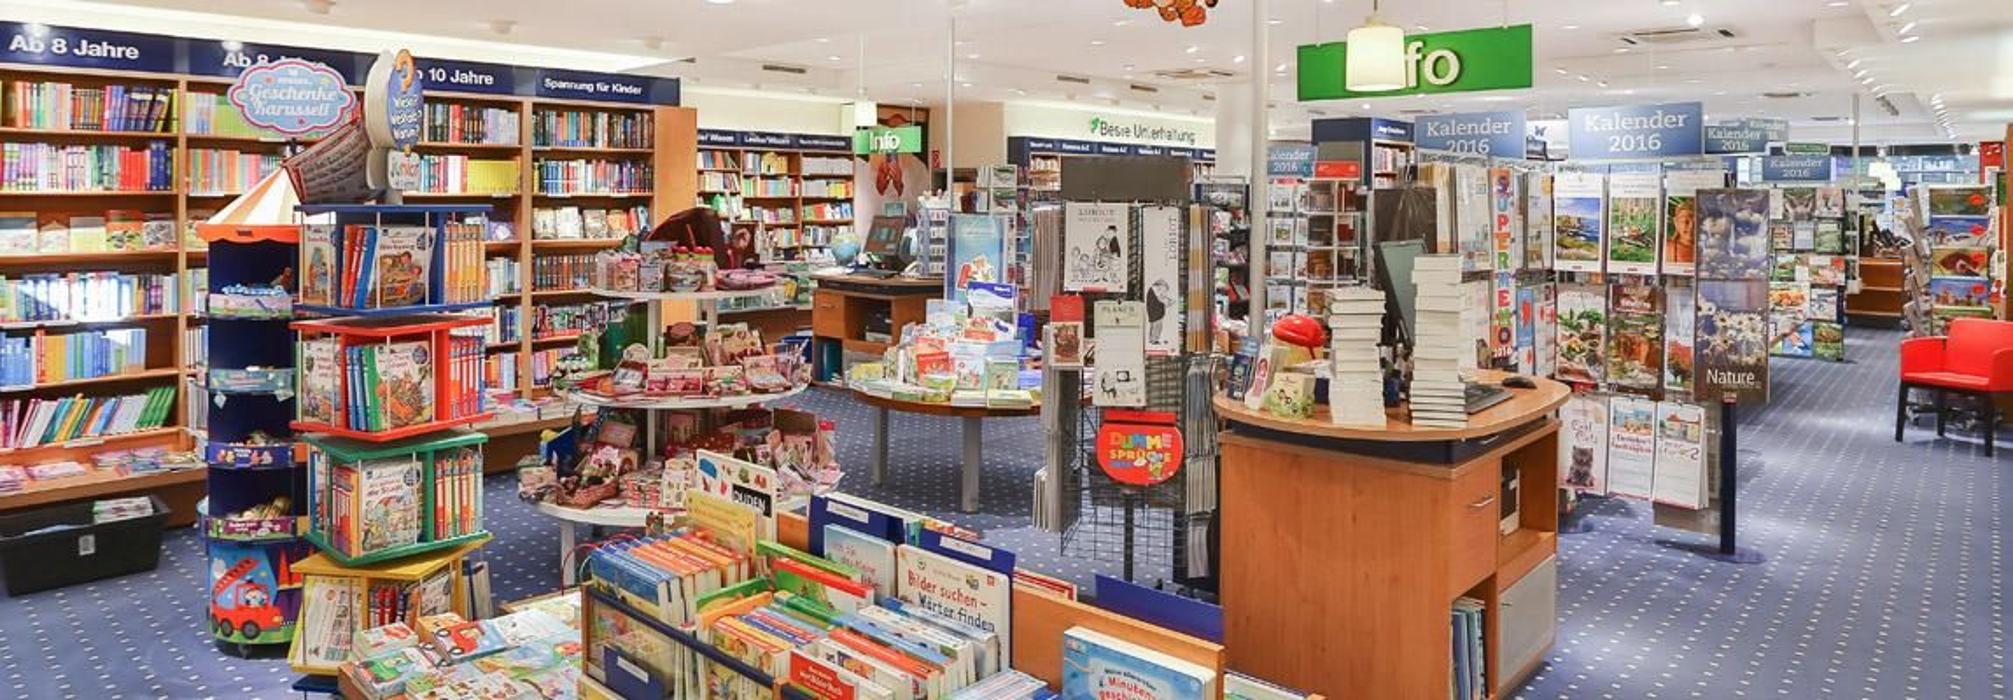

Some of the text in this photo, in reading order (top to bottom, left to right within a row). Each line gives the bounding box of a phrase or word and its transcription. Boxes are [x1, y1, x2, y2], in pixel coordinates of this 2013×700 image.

[10, 34, 140, 60] Ab 8 Jahre
[224, 52, 251, 67] Ab
[1404, 41, 1461, 88] fo
[428, 69, 494, 85] 10 Jahre
[544, 78, 642, 95] Spannung für Kinder
[1426, 118, 1512, 137] Kalender
[1584, 110, 1688, 132] Kalender
[869, 131, 900, 151] Info
[1707, 127, 1761, 140] Kalender
[1446, 139, 1490, 155] 2016
[1608, 133, 1662, 152] 2016
[1721, 140, 1749, 150] 2016
[1270, 148, 1313, 160] alender
[1273, 162, 1298, 172] 2016
[1770, 158, 1824, 168] Kalender
[1783, 168, 1810, 178] 2016
[1706, 369, 1755, 385] Nature
[1109, 432, 1173, 449] DUMME
[908, 569, 937, 593] Bilder
[940, 587, 978, 608] suchen
[958, 606, 995, 632] finden
